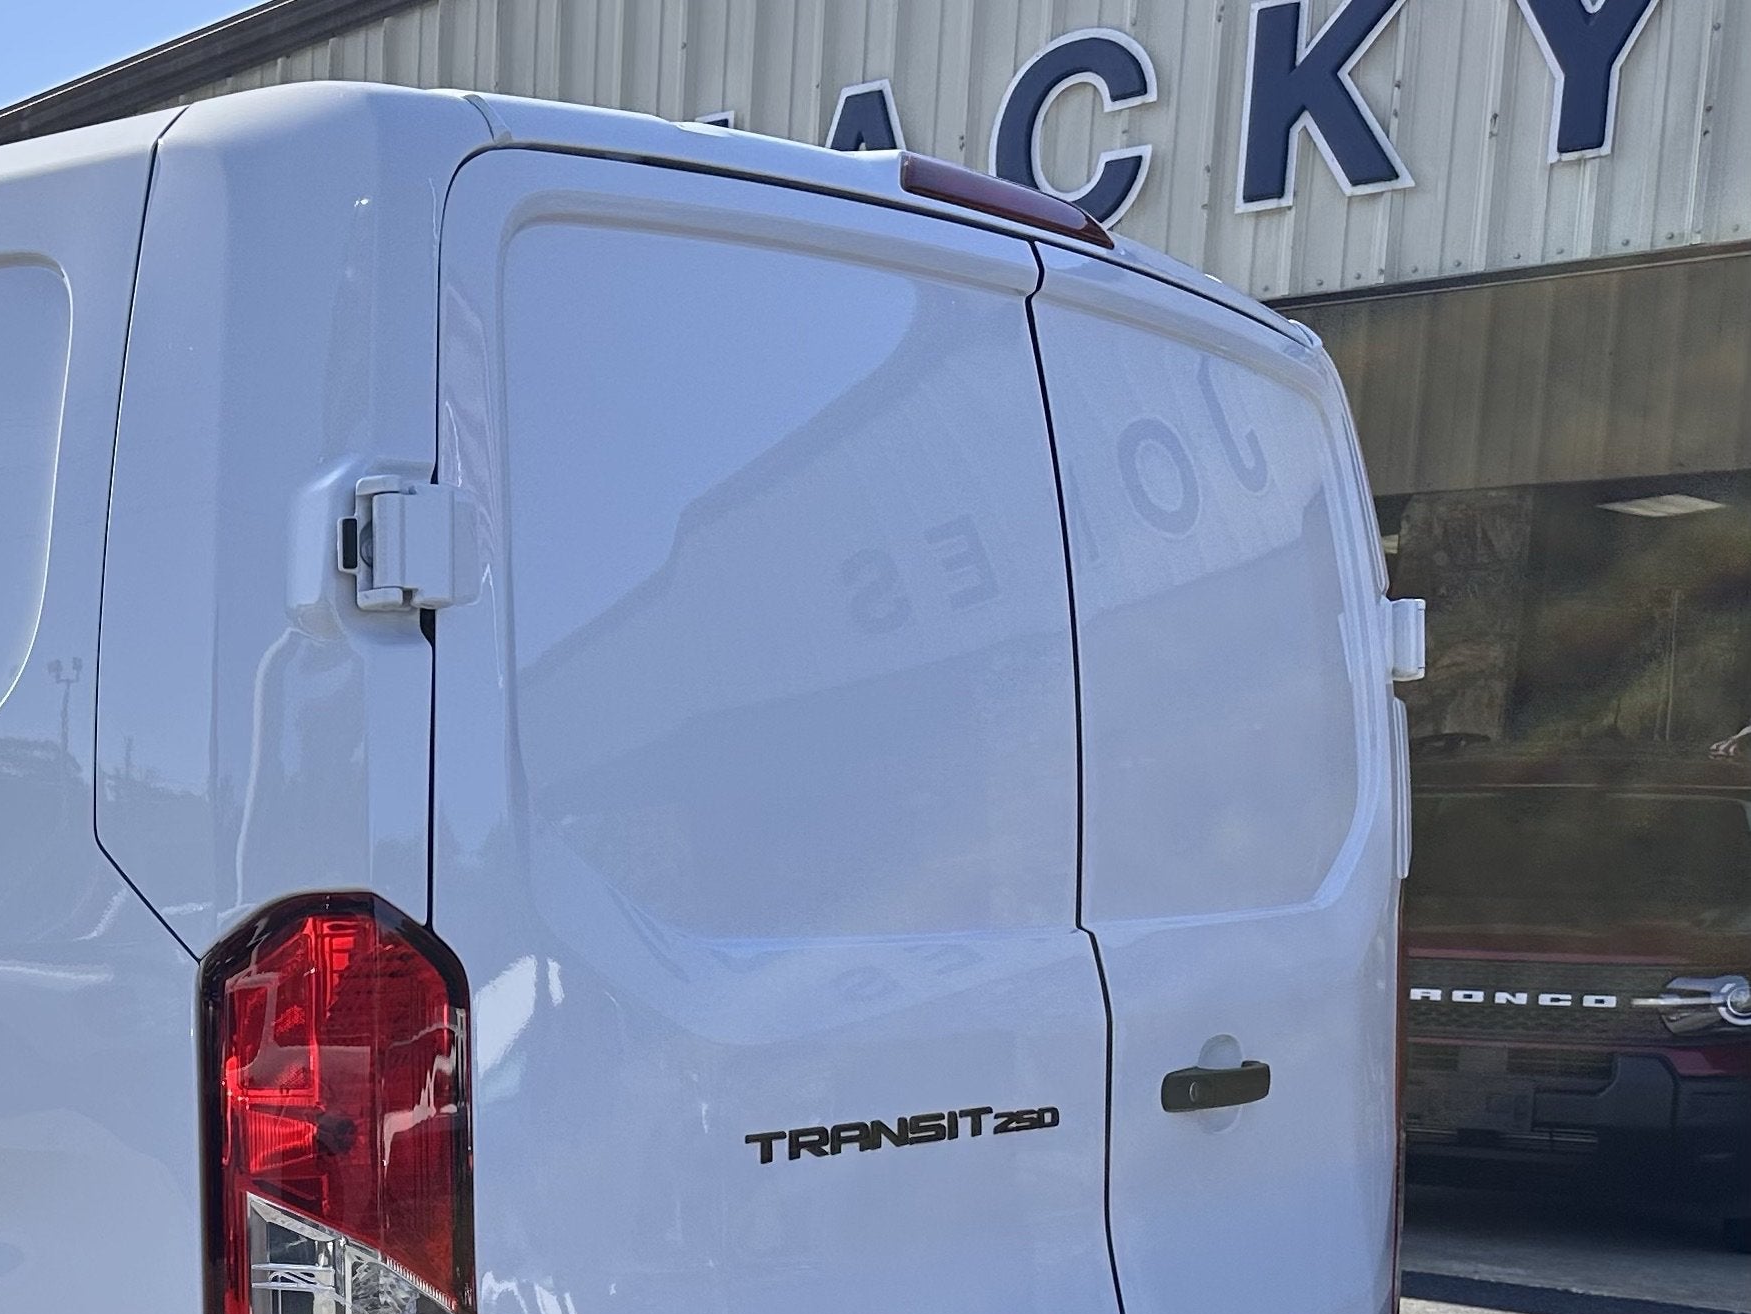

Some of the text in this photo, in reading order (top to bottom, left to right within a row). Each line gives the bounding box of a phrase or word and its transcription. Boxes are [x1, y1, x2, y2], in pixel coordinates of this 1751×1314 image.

[696, 0, 1662, 230] CKY
[1409, 987, 1618, 1009] RONCO
[745, 1105, 1060, 1165] TRANSIT 250
